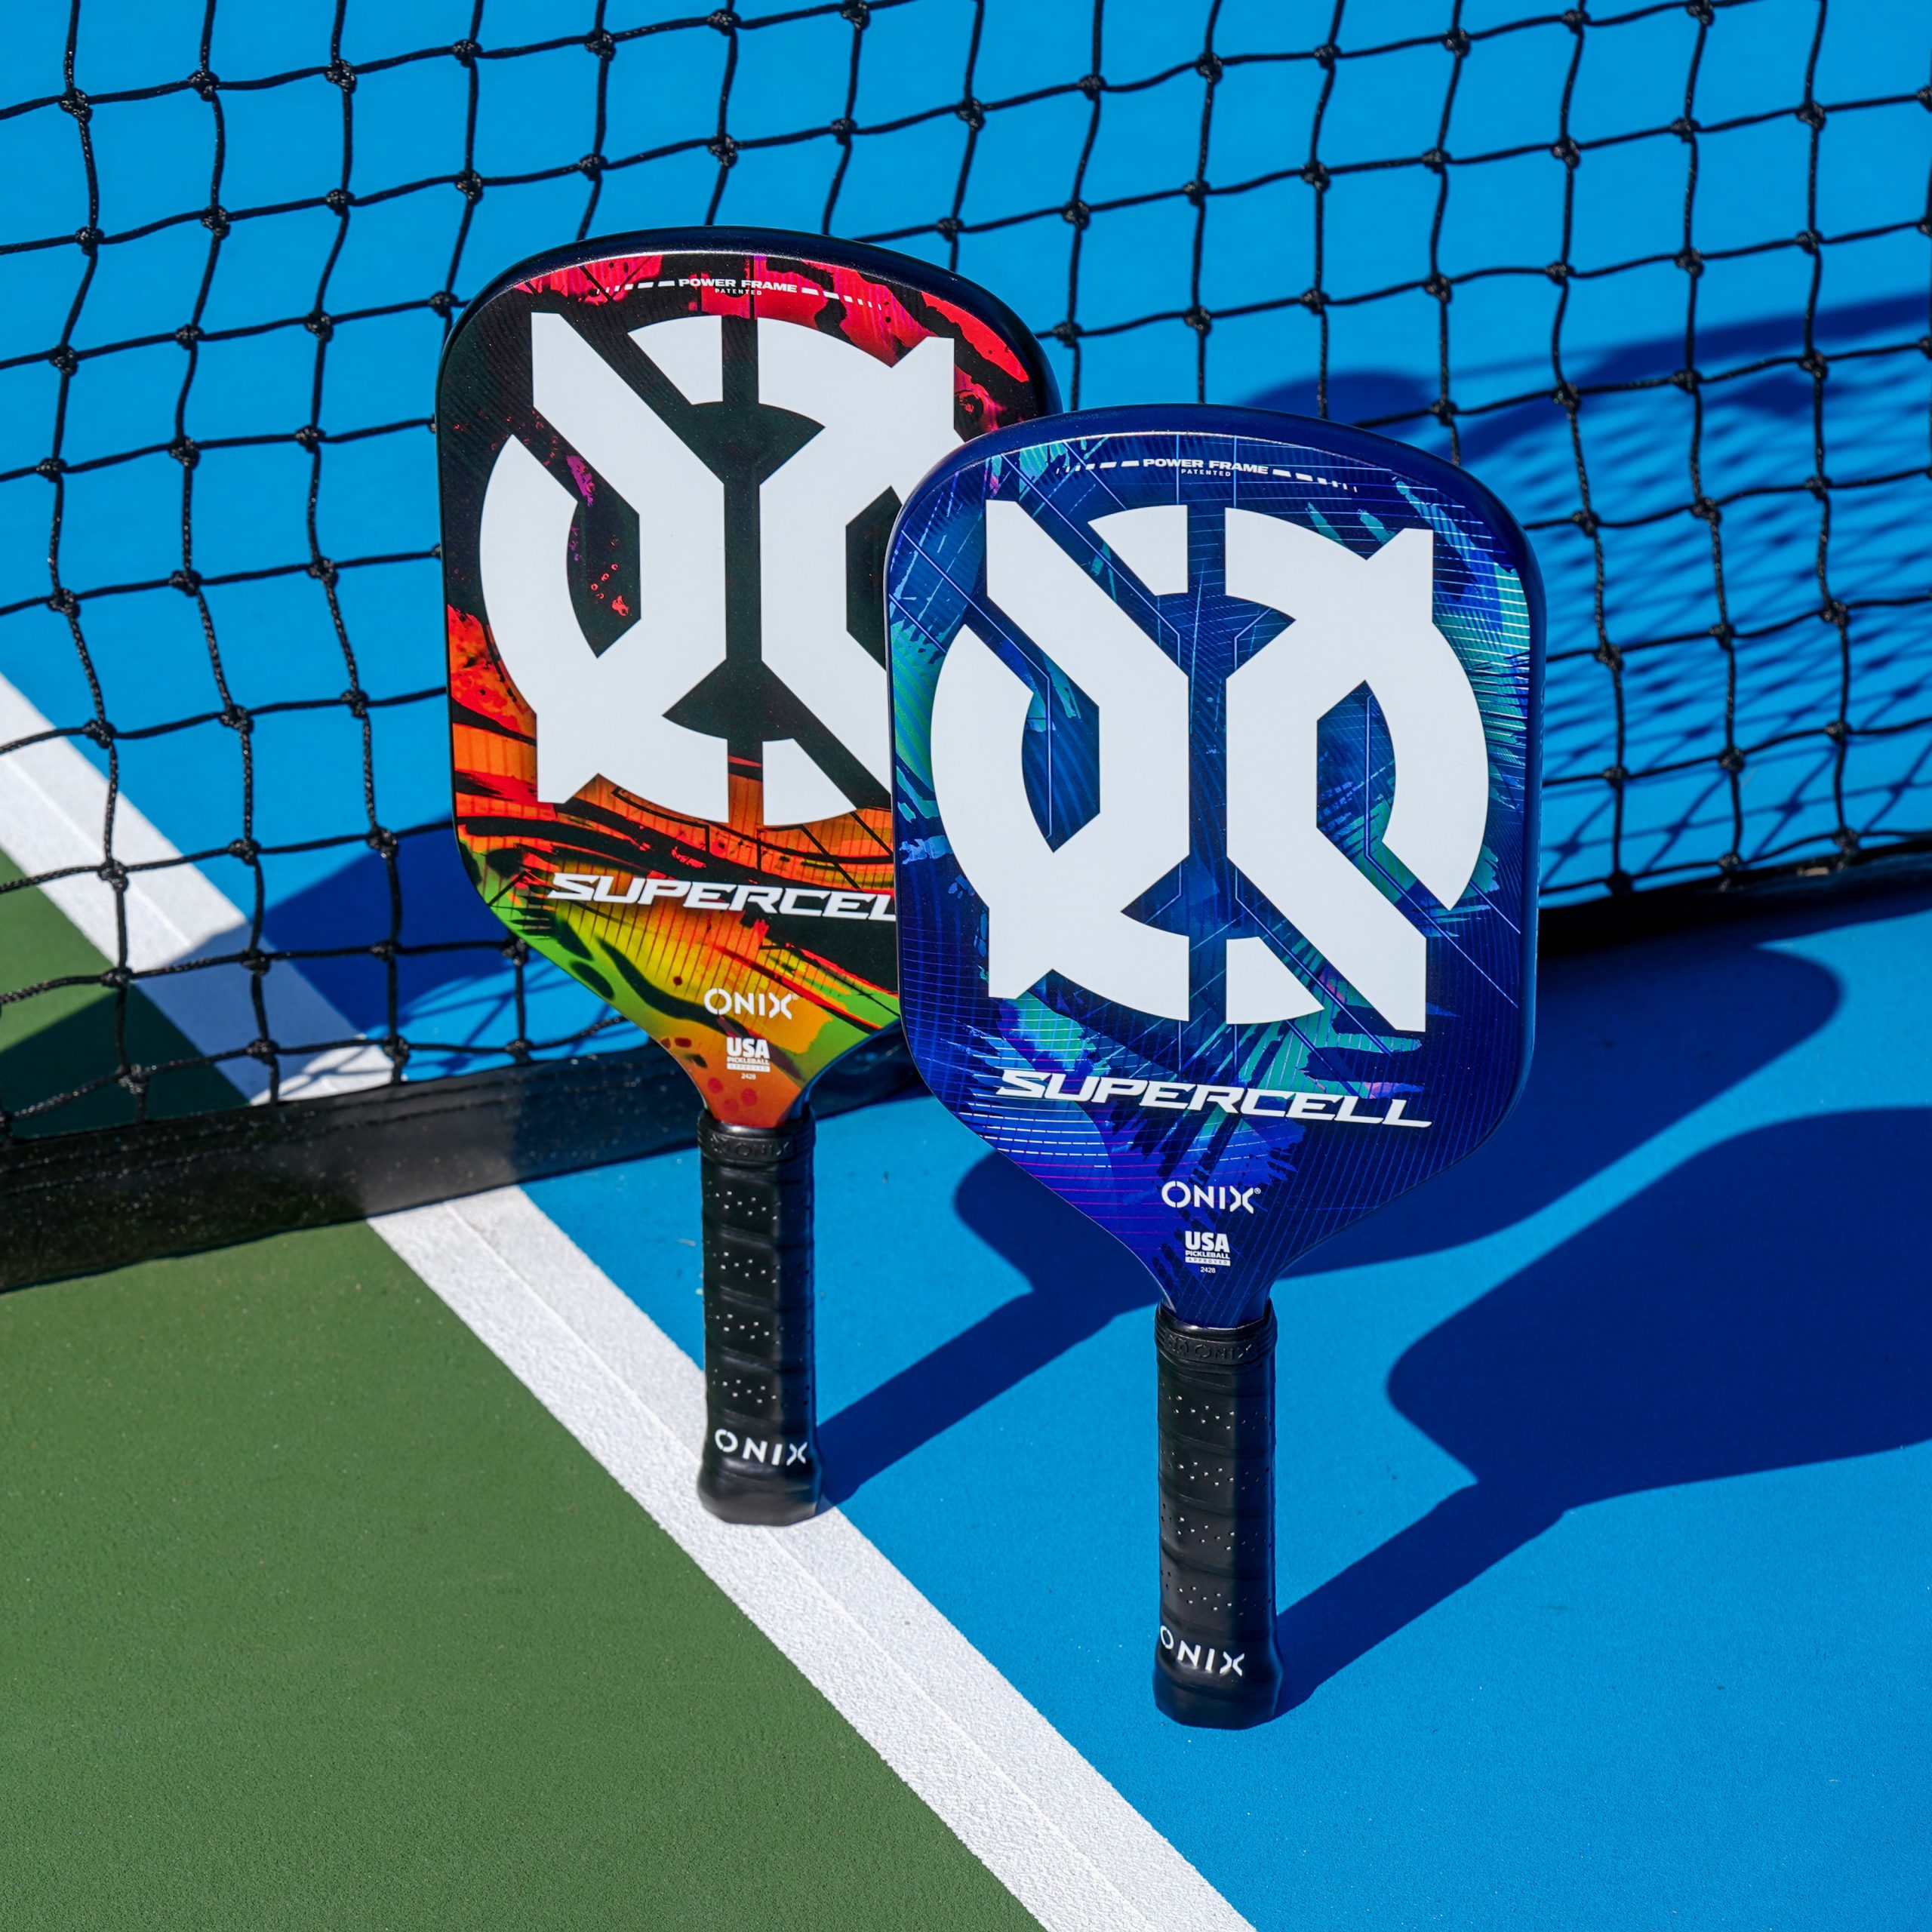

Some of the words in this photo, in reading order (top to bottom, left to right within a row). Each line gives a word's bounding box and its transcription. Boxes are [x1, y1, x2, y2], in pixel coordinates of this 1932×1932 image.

[678, 278, 737, 288] POWER
[741, 279, 798, 294] FRAME
[715, 288, 762, 296] PATENTED
[1143, 458, 1204, 468] POWER
[1209, 460, 1269, 475] FRAME
[1181, 469, 1232, 477] PATENTED
[726, 1036, 771, 1060] USA
[995, 1068, 1432, 1128] SUPERCELL
[1185, 1230, 1231, 1253] USA
[1185, 1250, 1231, 1260] PICKLEBALL
[714, 1428, 808, 1466] ONIX
[1159, 1624, 1245, 1678] ONIX
